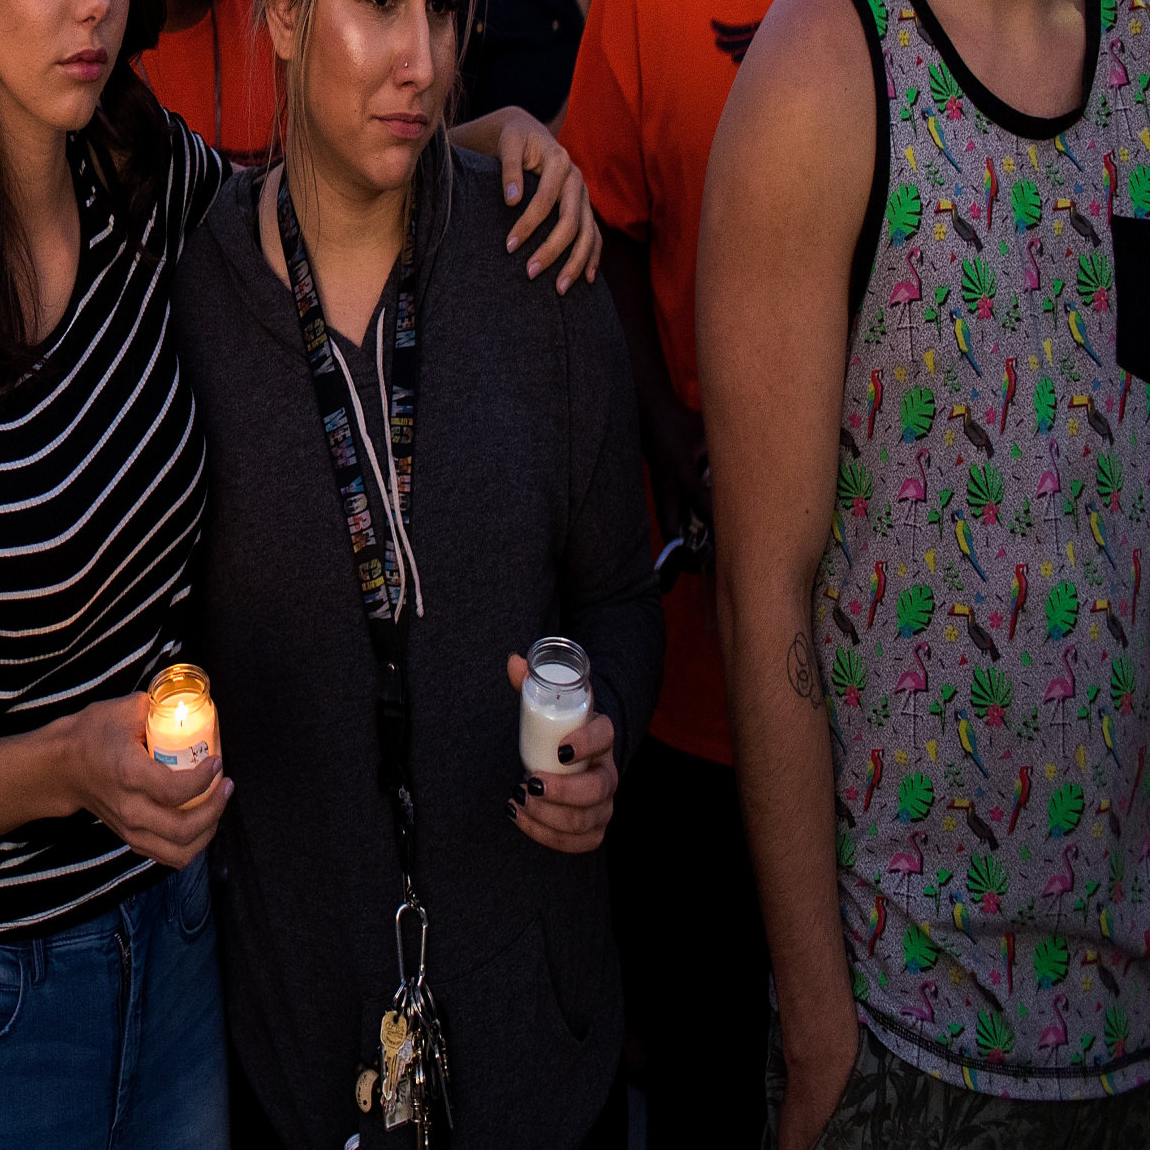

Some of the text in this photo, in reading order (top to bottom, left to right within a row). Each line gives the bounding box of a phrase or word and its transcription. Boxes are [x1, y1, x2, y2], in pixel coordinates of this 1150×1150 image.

[288, 241, 319, 319] YORK
[304, 317, 337, 378] CITY
[395, 292, 416, 348] NEW
[323, 407, 358, 470] NEW
[391, 385, 415, 445] CITY
[340, 476, 377, 554] YORK
[358, 557, 393, 620] CITY
